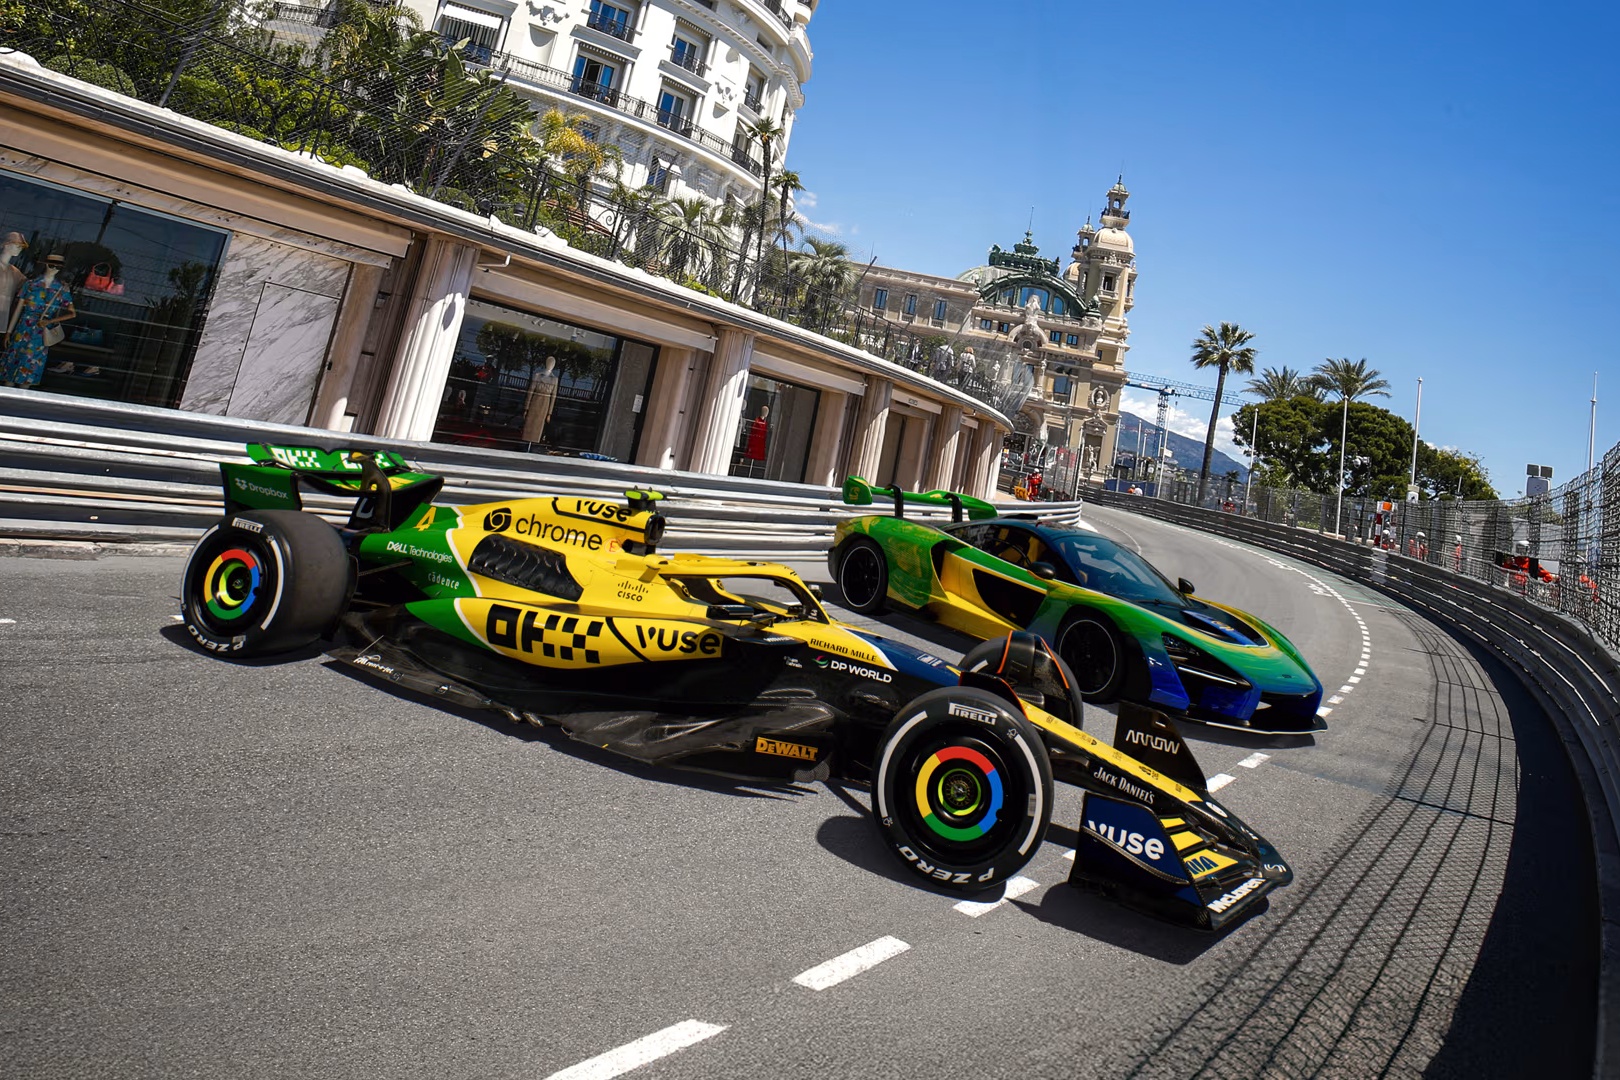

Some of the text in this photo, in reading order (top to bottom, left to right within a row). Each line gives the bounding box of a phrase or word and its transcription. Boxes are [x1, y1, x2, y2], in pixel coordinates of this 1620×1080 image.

[249, 482, 288, 499] Dropbox
[231, 517, 264, 534] PIRELLI
[412, 506, 435, 531] 4
[515, 513, 603, 551] chrome
[386, 541, 453, 563] DELL Technologies
[617, 591, 643, 602] CISCO
[187, 624, 244, 652] P ZERO
[486, 603, 604, 664] OKX
[810, 638, 848, 654] RICHARD
[850, 649, 877, 662] MILLE
[830, 660, 892, 683] DP WORLD
[948, 702, 998, 726] PIRELLI
[899, 845, 995, 884] P ZERO
[1207, 877, 1267, 914] McLaren
